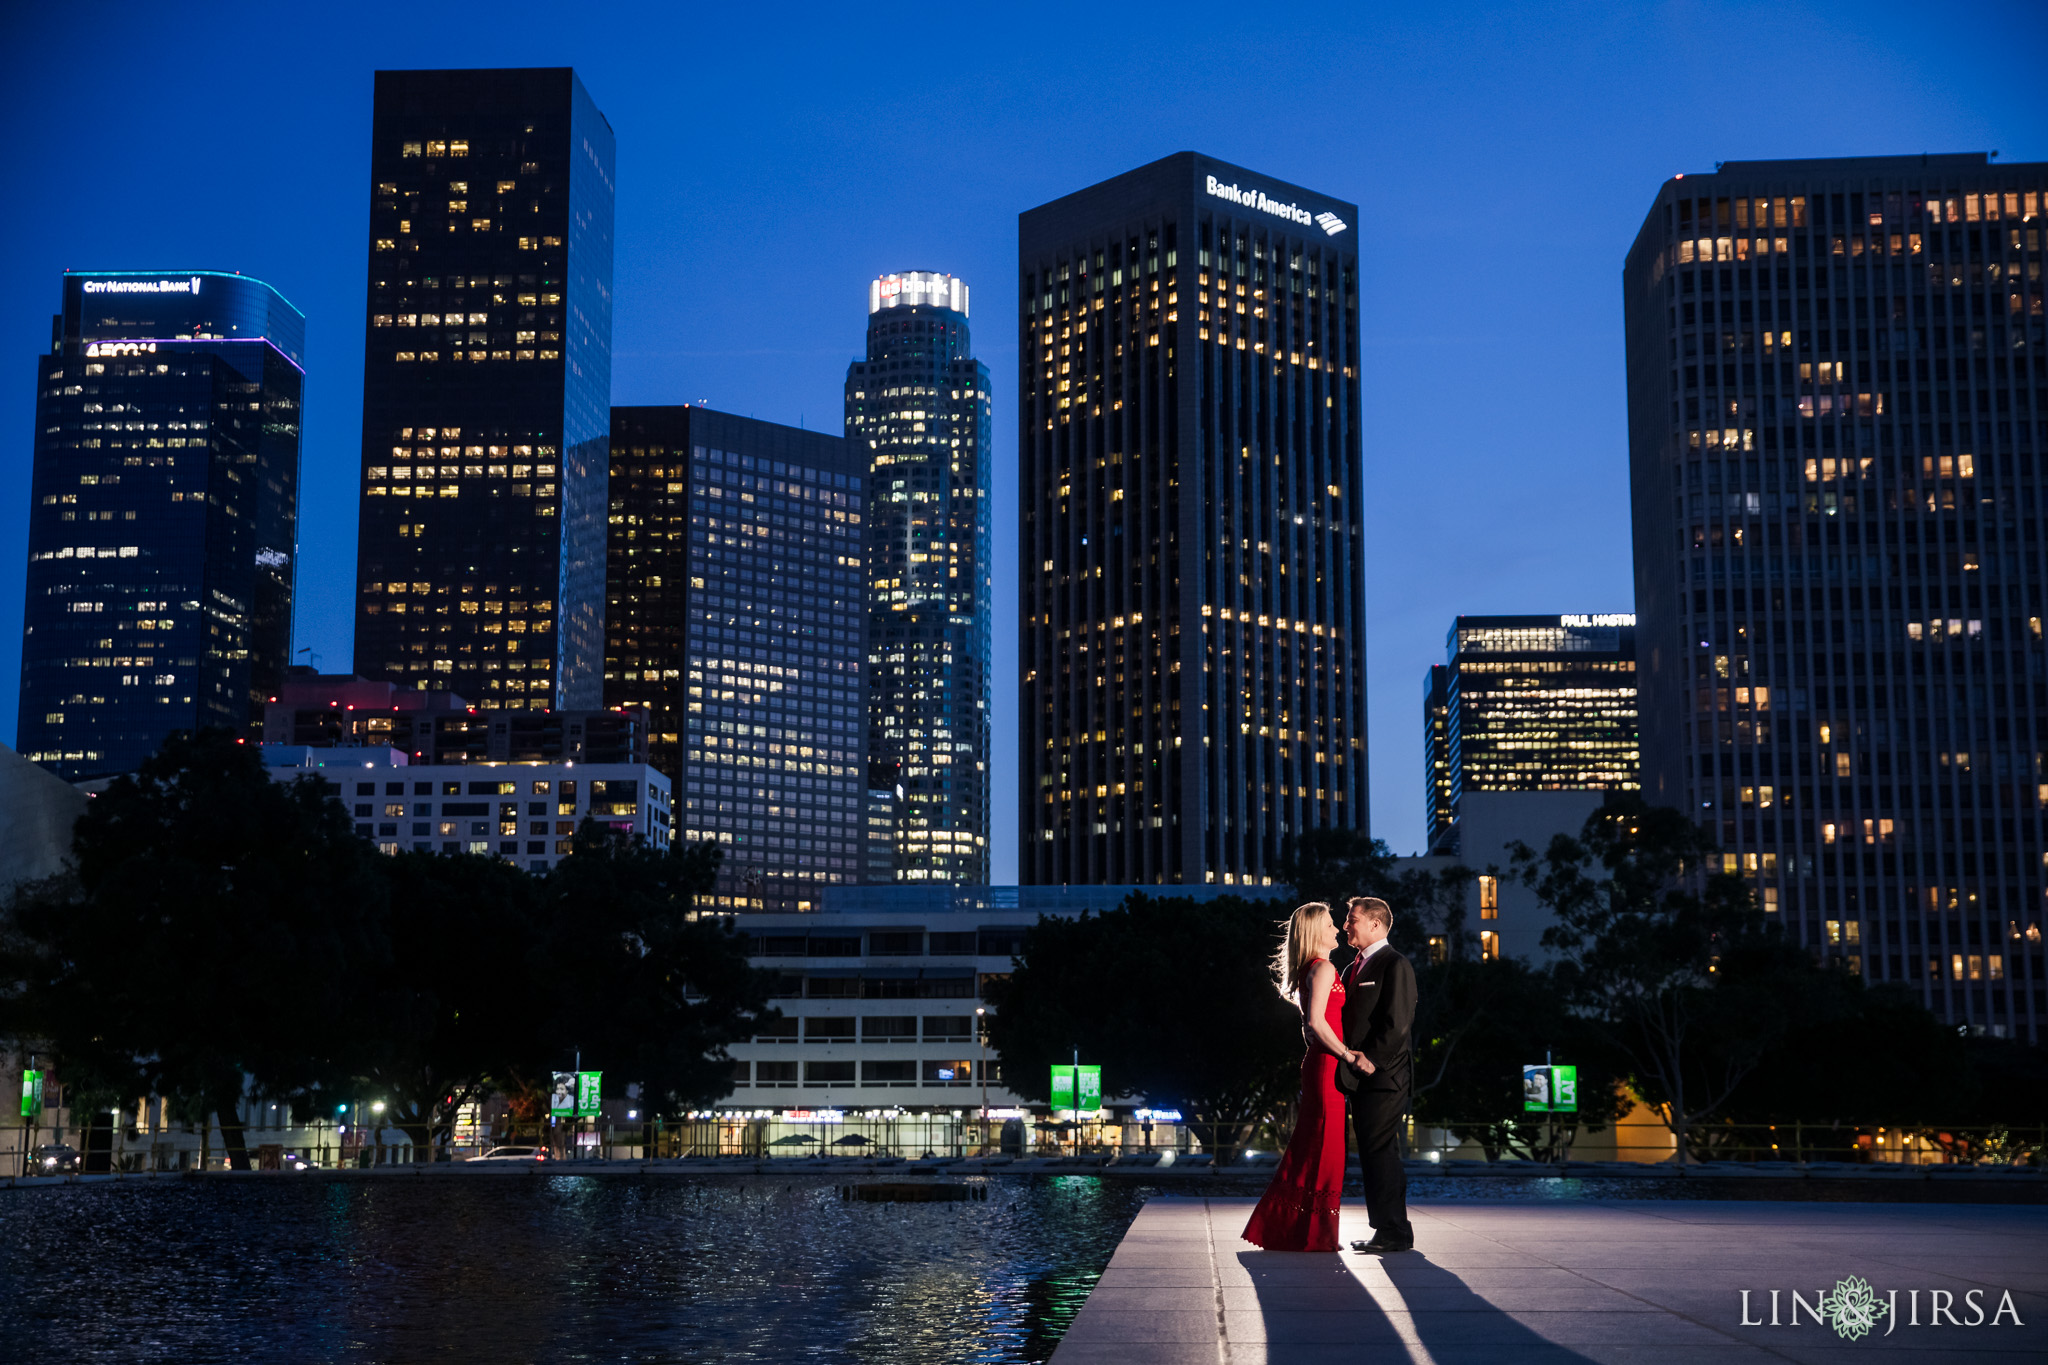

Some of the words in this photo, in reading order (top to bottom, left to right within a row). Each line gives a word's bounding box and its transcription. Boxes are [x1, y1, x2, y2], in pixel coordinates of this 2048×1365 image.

[1206, 175, 1241, 204] Bank
[1242, 189, 1257, 208] of
[1257, 192, 1312, 226] America
[901, 278, 949, 295] bank
[1561, 614, 1592, 627] PAUL
